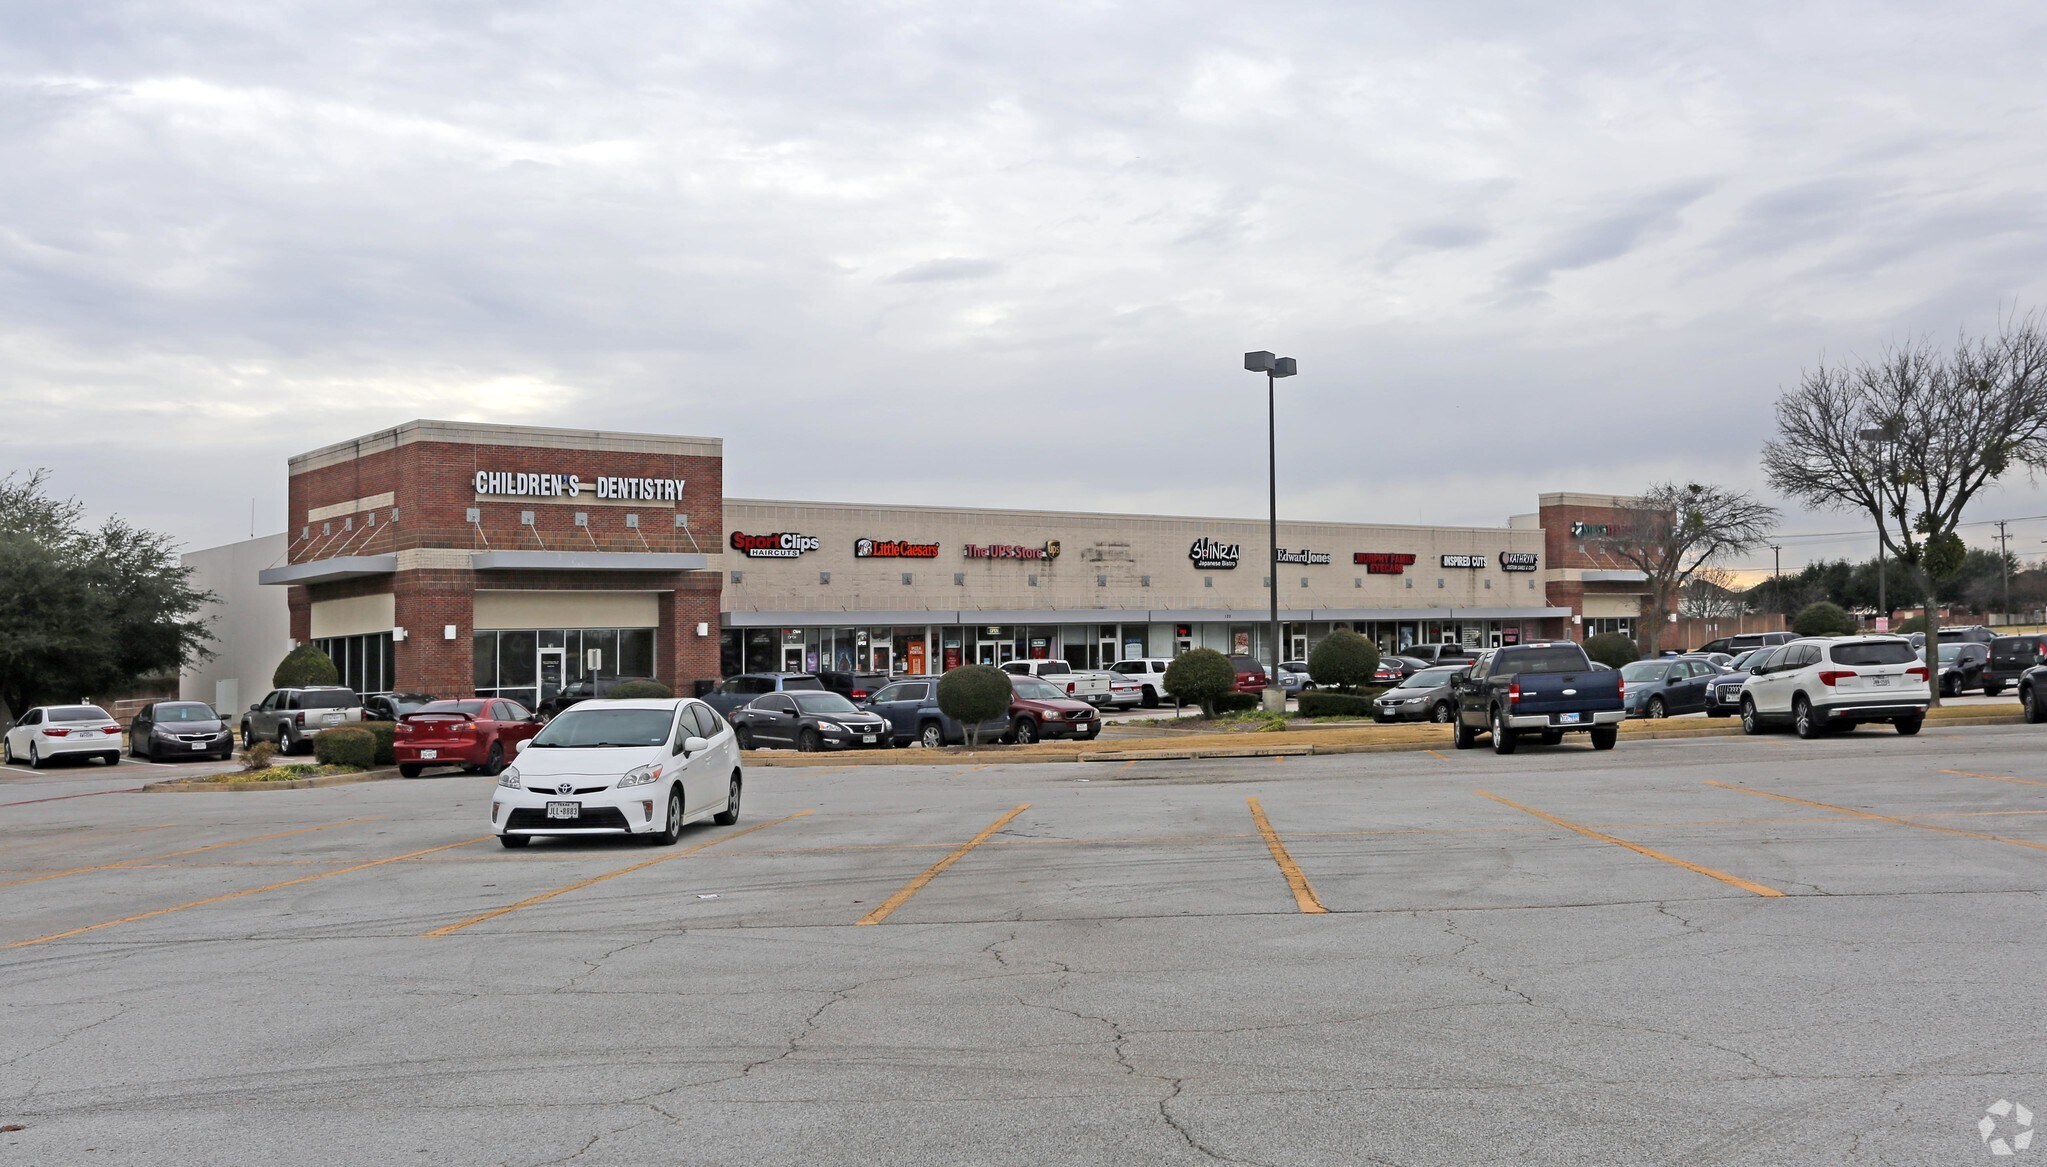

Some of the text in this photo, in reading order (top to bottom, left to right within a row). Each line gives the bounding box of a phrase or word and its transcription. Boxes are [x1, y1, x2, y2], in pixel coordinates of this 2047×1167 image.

[476, 471, 686, 501] CHILDREN'S DENTISTRY
[873, 541, 938, 557] Little Caesars
[966, 544, 1043, 558] The UPS Store
[1307, 550, 1333, 563] Jones
[1357, 553, 1416, 563] MURPHY FAMILY
[1443, 556, 1488, 567] INSPIRED CUTS
[1509, 553, 1539, 564] KATHRYN'S
[1370, 563, 1404, 573] EYECARE
